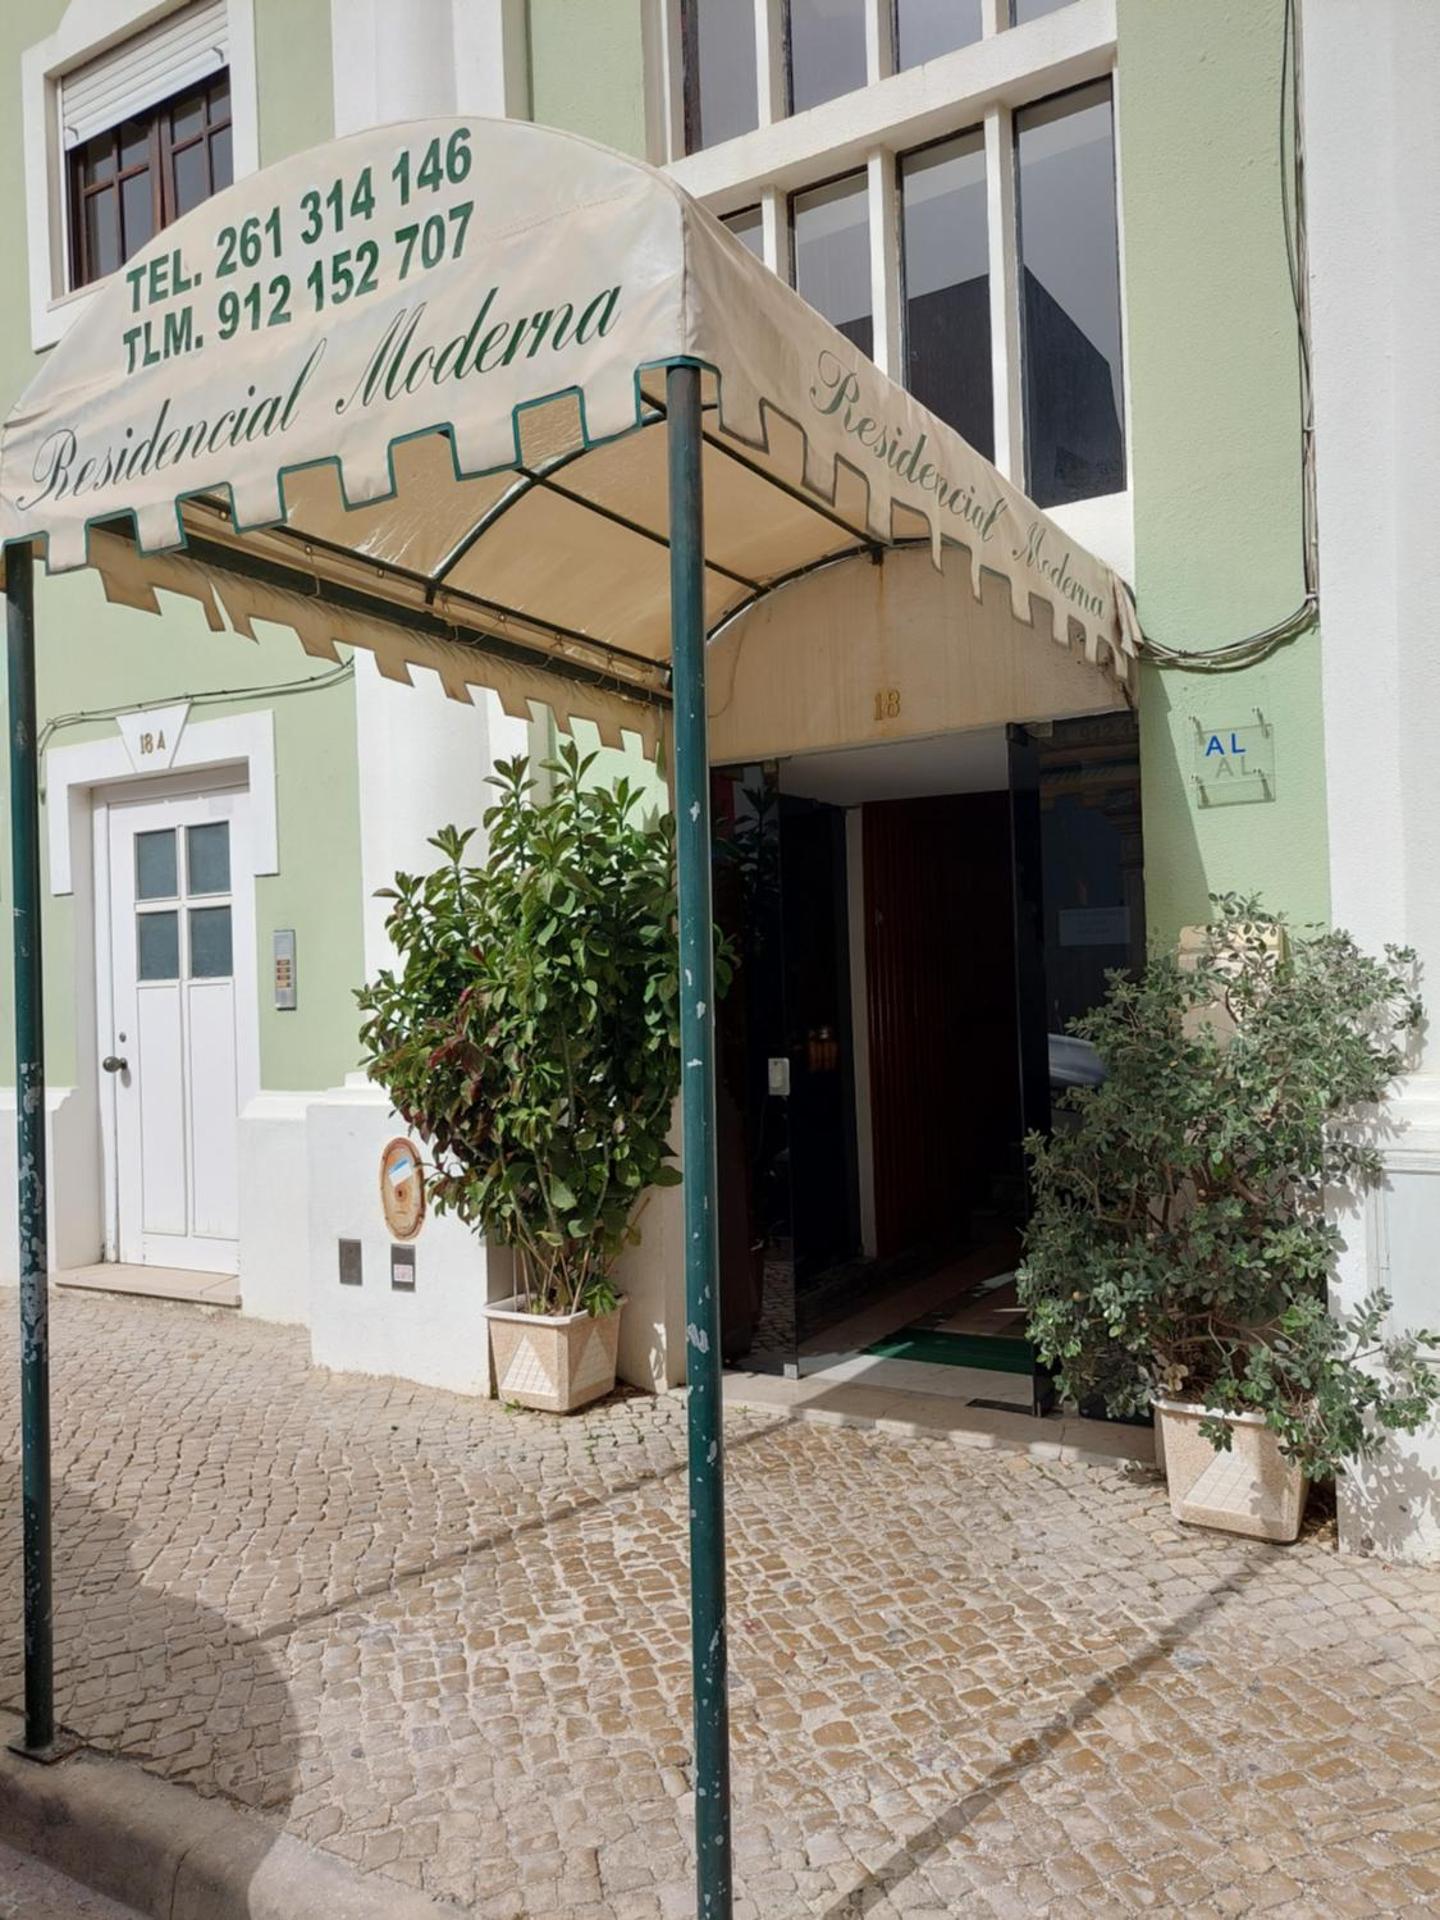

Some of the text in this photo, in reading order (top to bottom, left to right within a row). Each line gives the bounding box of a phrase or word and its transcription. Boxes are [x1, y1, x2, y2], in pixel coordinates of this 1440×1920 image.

[122, 201, 475, 375] TLM. 912 152 707
[126, 127, 472, 313] TEL. 261 314 146
[17, 285, 623, 511] Residencial Moderna
[810, 350, 1106, 621] Residencial Moderna
[873, 688, 901, 721] 18
